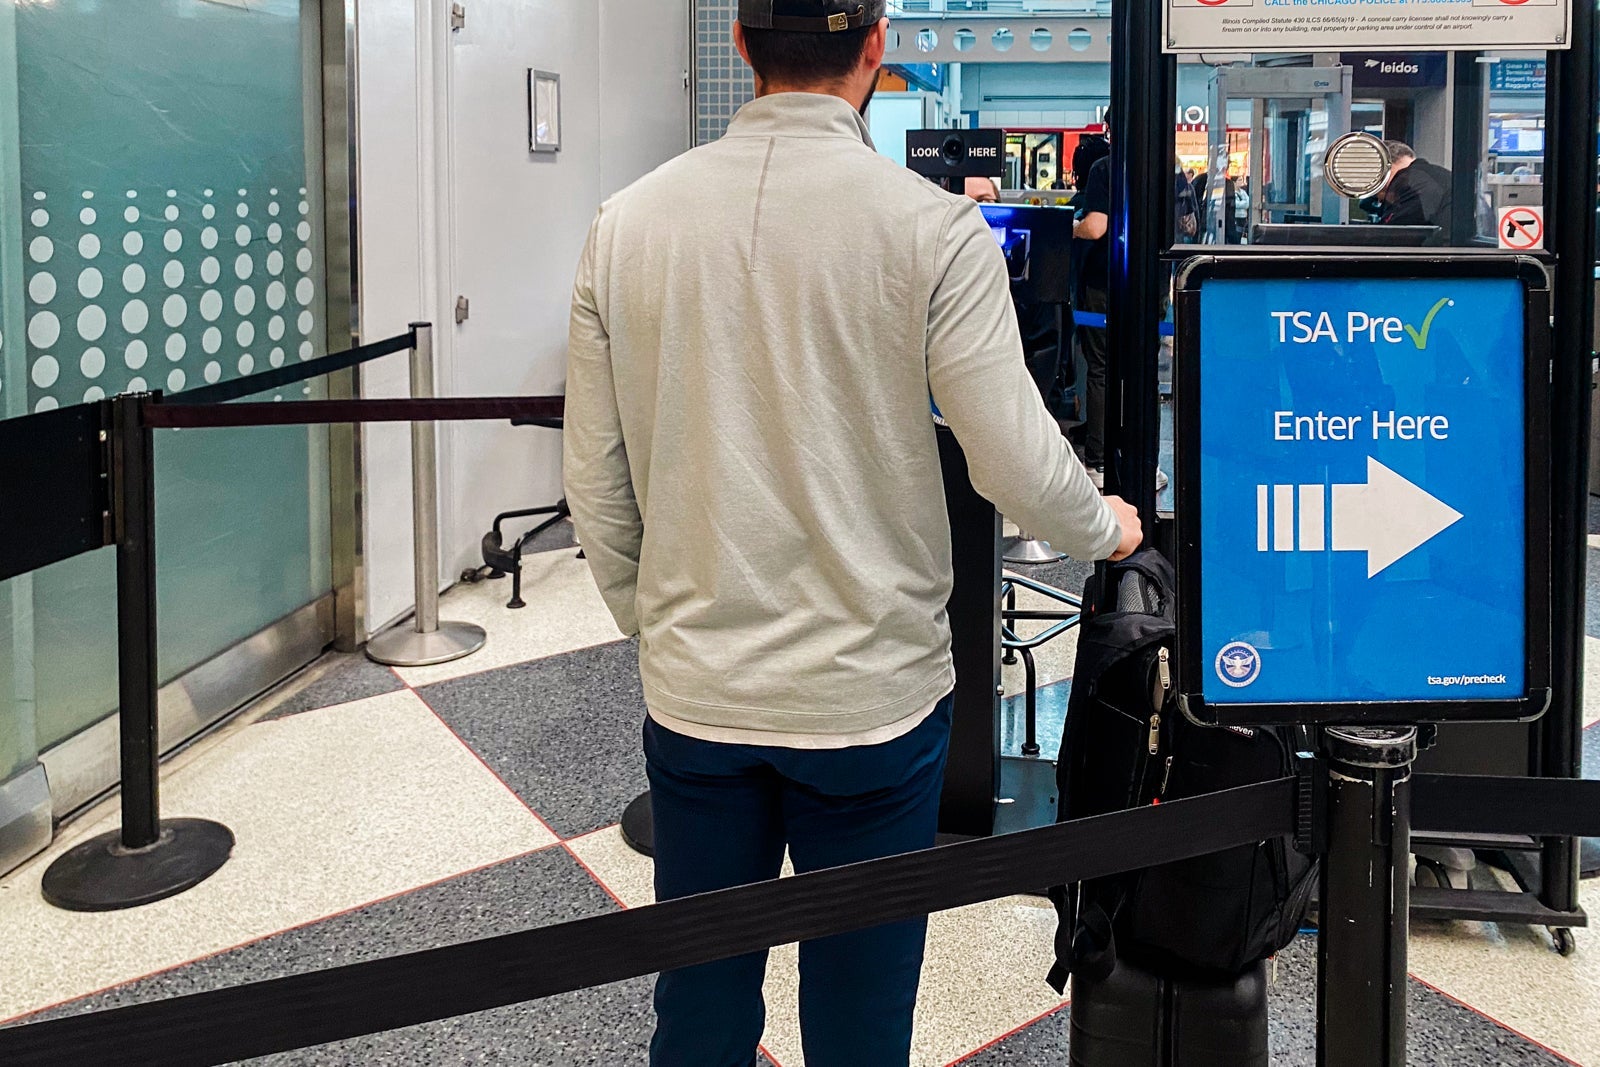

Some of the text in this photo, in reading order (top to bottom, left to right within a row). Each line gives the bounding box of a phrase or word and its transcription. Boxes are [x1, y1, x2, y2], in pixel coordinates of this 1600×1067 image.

[1461, 14, 1491, 22] knowingly
[1273, 26, 1284, 34] any
[1323, 25, 1349, 33] property
[1357, 24, 1379, 32] parking
[1380, 61, 1419, 74] leidos
[911, 147, 997, 157] LOOK HERE
[1270, 311, 1403, 343] TSA Pre
[1274, 410, 1449, 441] Enter Here
[1427, 673, 1506, 686] tsa.gov/precheck
